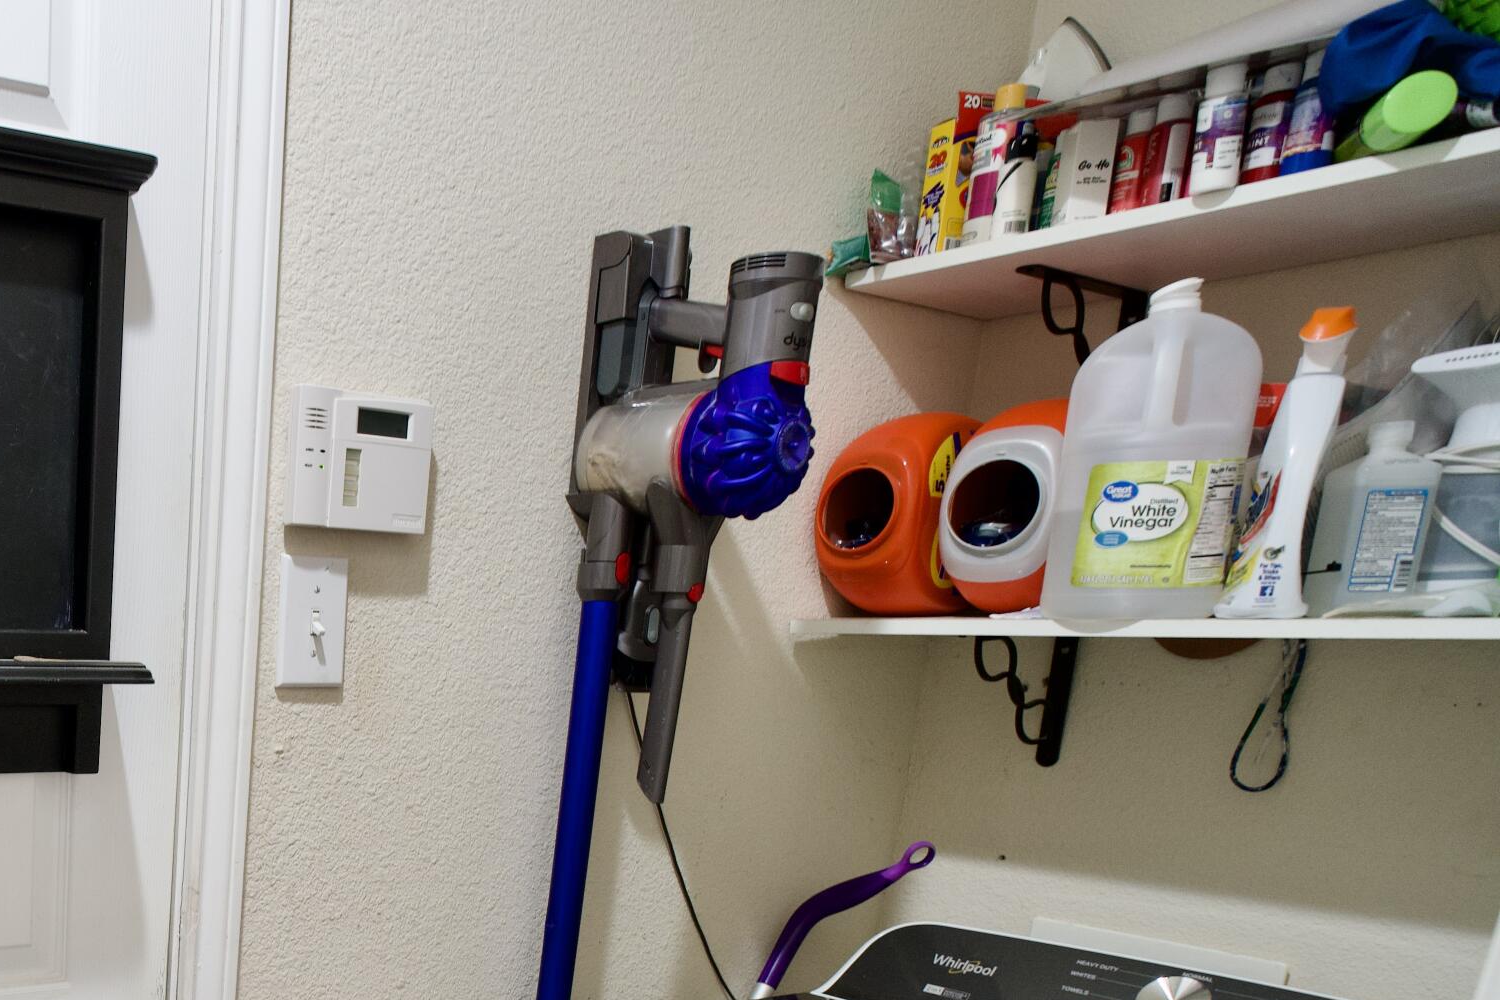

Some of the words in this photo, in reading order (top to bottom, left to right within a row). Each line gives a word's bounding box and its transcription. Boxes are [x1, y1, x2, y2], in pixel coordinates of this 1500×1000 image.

[964, 94, 980, 108] 20
[1106, 484, 1133, 495] Great
[1131, 505, 1177, 517] White
[1109, 516, 1175, 531] Vinegar
[933, 953, 998, 977] Whirlpool
[1076, 959, 1100, 970] HEAVY
[1100, 963, 1120, 973] DUTY
[1070, 970, 1097, 980] WHITES
[1061, 984, 1089, 996] TOWELS
